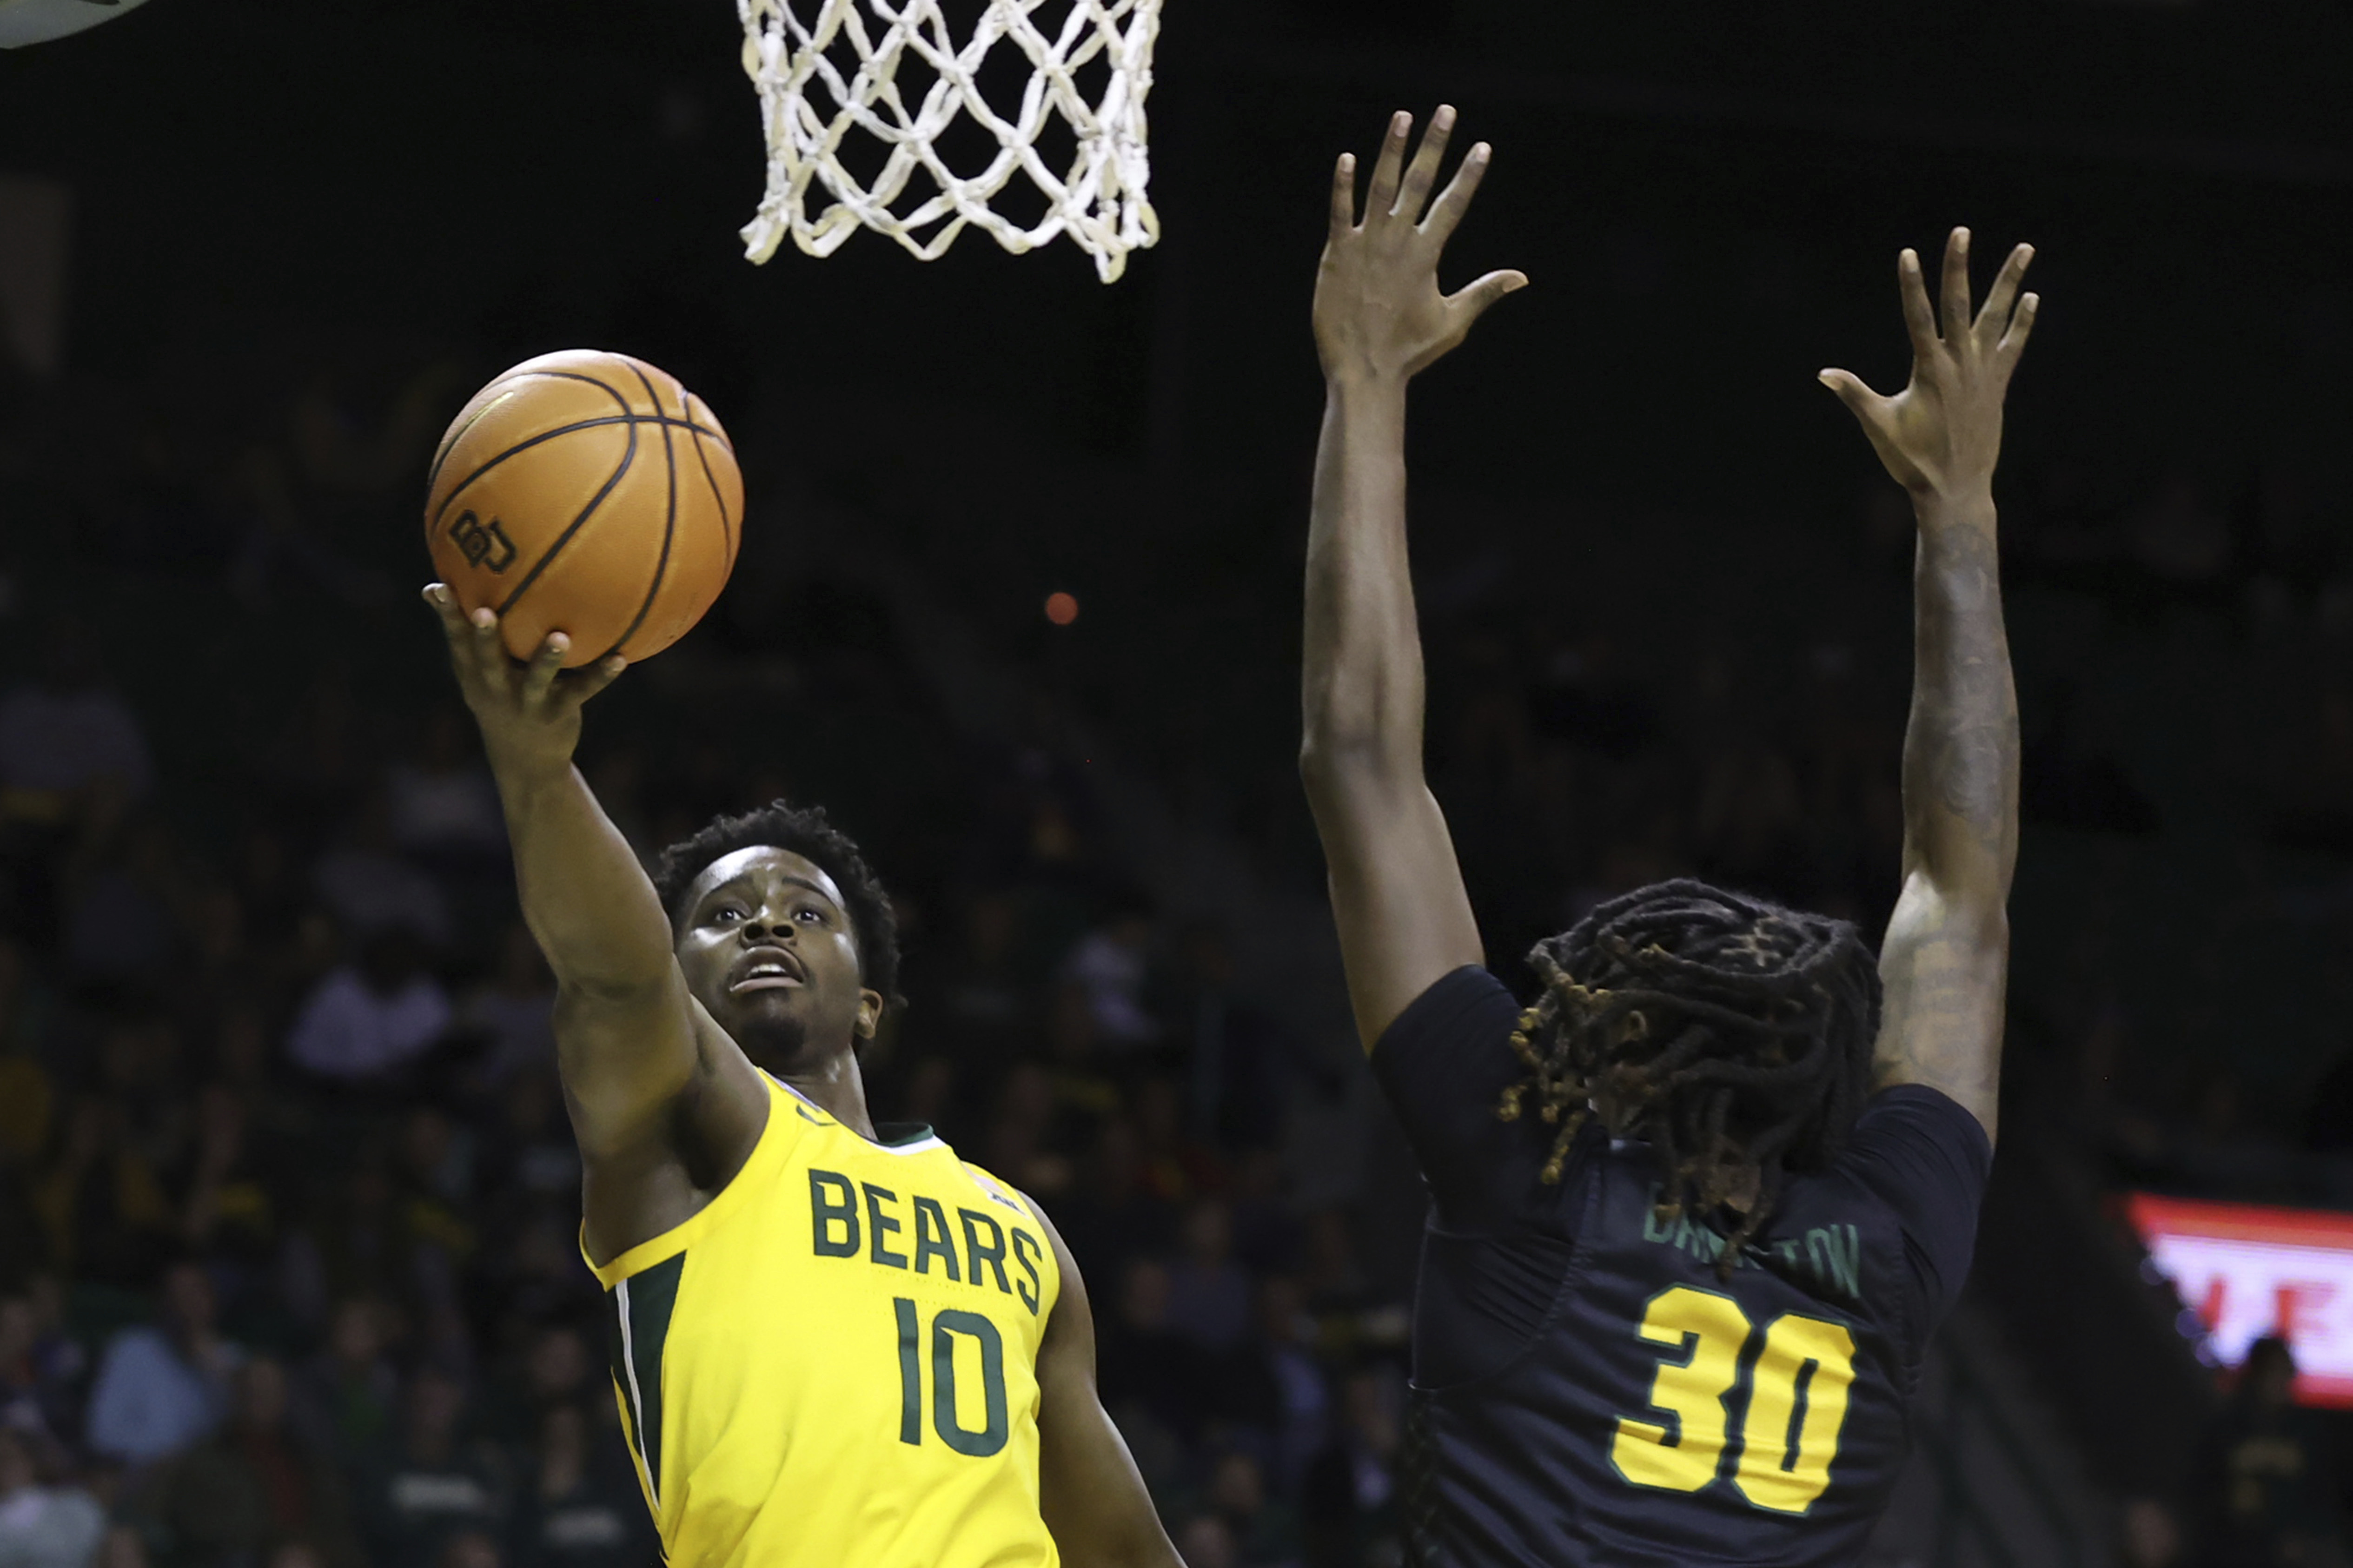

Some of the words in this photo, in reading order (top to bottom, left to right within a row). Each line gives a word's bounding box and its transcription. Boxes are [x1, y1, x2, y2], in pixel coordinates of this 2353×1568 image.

[808, 1168, 1042, 1317] BEARS
[893, 1297, 1009, 1457] 10
[1605, 1282, 1858, 1517] 30
